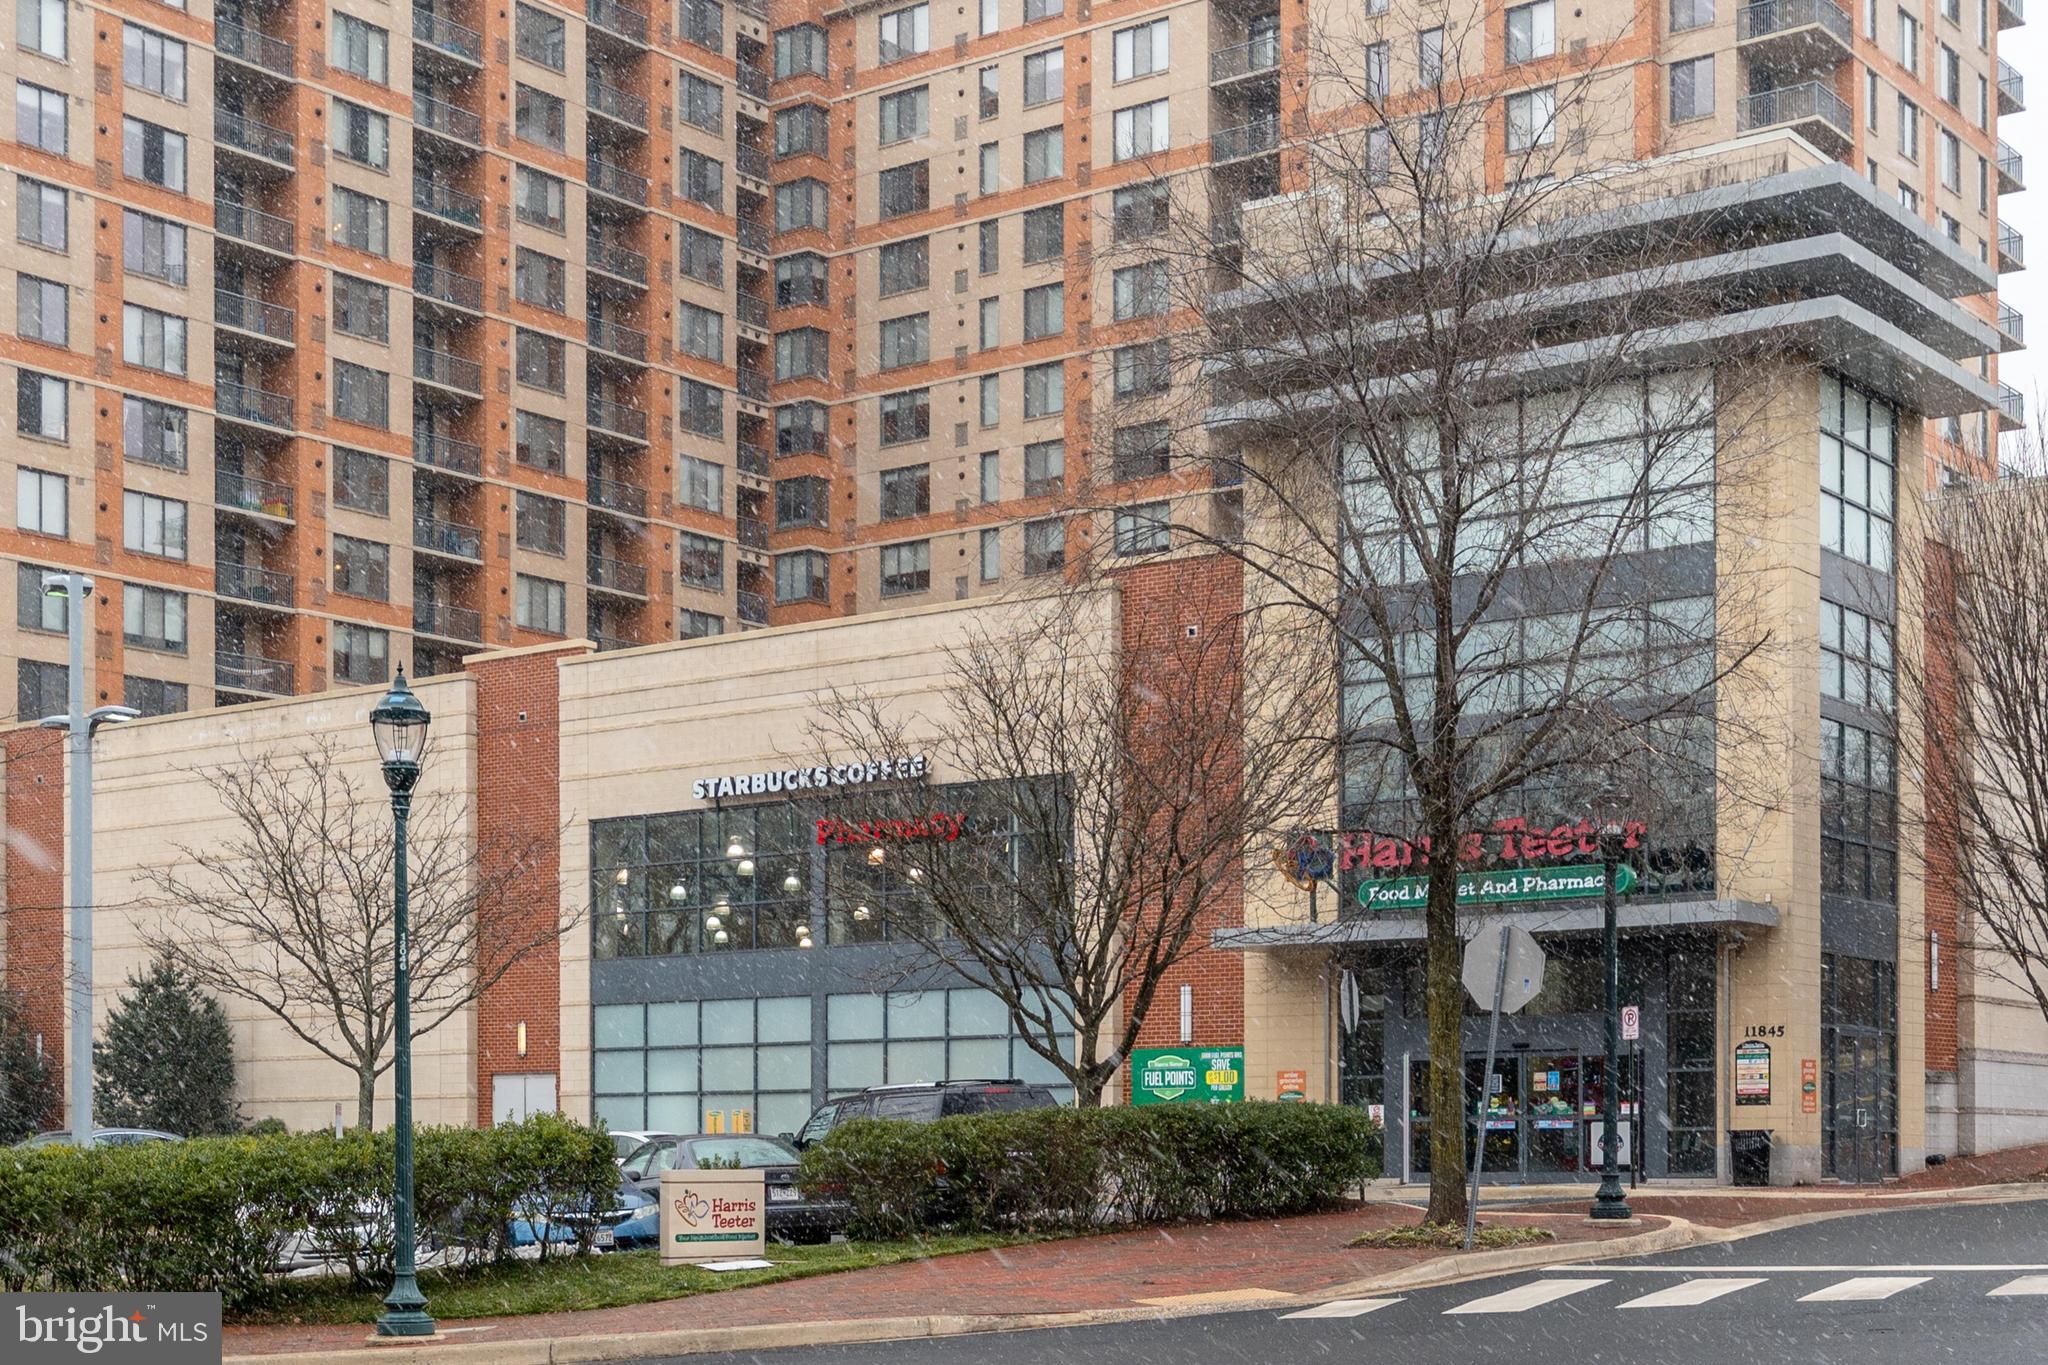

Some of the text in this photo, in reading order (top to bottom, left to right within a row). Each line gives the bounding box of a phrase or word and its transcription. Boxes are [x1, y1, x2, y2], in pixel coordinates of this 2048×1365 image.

[692, 754, 924, 799] STARBUCKS COFFEE
[1492, 815, 1648, 859] Teetr
[1368, 885, 1410, 901] Food
[1480, 877, 1518, 895] And
[1522, 873, 1608, 893] Pharmac
[1744, 1025, 1785, 1038] 11845
[1211, 1059, 1231, 1070] SAVE
[1144, 1071, 1163, 1086] FUEL
[1164, 1070, 1194, 1086] POINTS
[712, 1198, 756, 1213] Harris
[711, 1213, 755, 1228] Teeter
